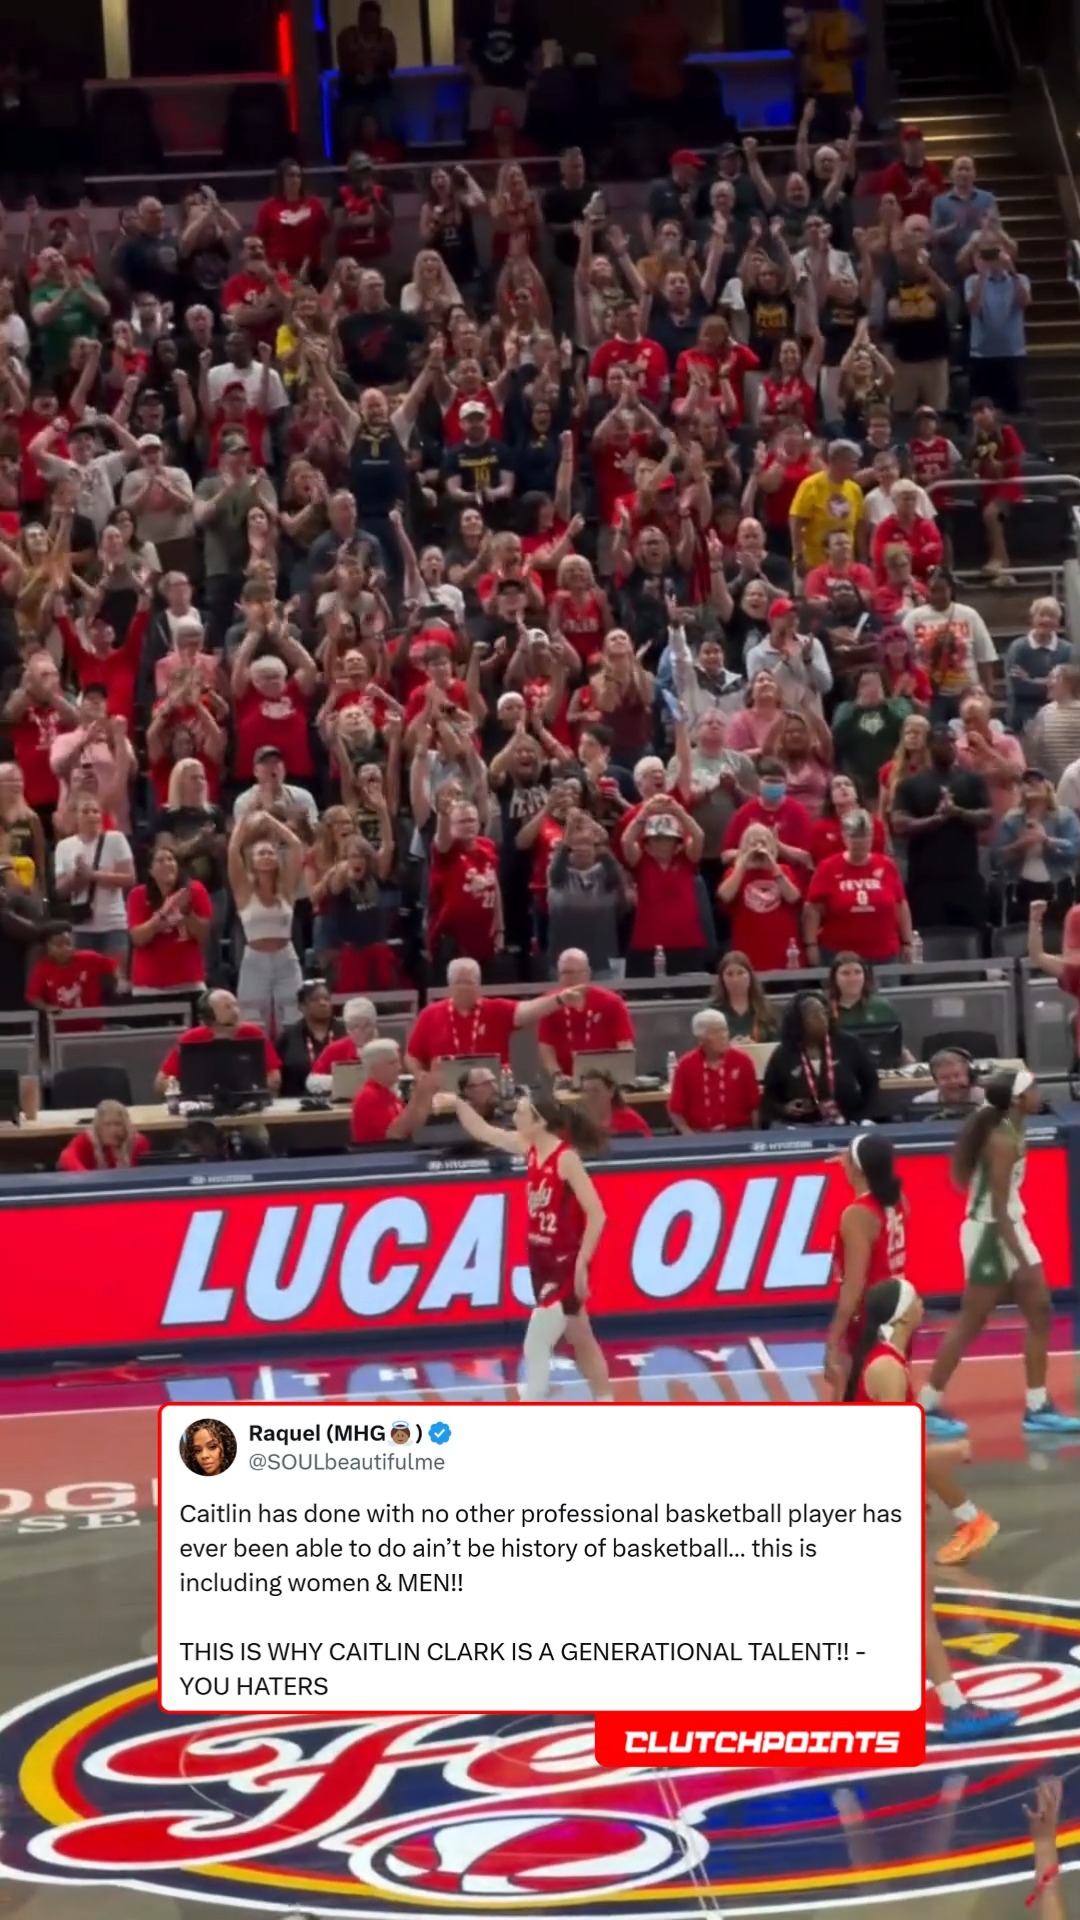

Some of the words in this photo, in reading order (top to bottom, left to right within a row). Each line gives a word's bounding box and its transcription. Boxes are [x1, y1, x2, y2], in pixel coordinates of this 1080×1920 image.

[161, 1187, 539, 1326] LUCA
[630, 1174, 833, 1299] OIL
[539, 1212, 558, 1234] 22
